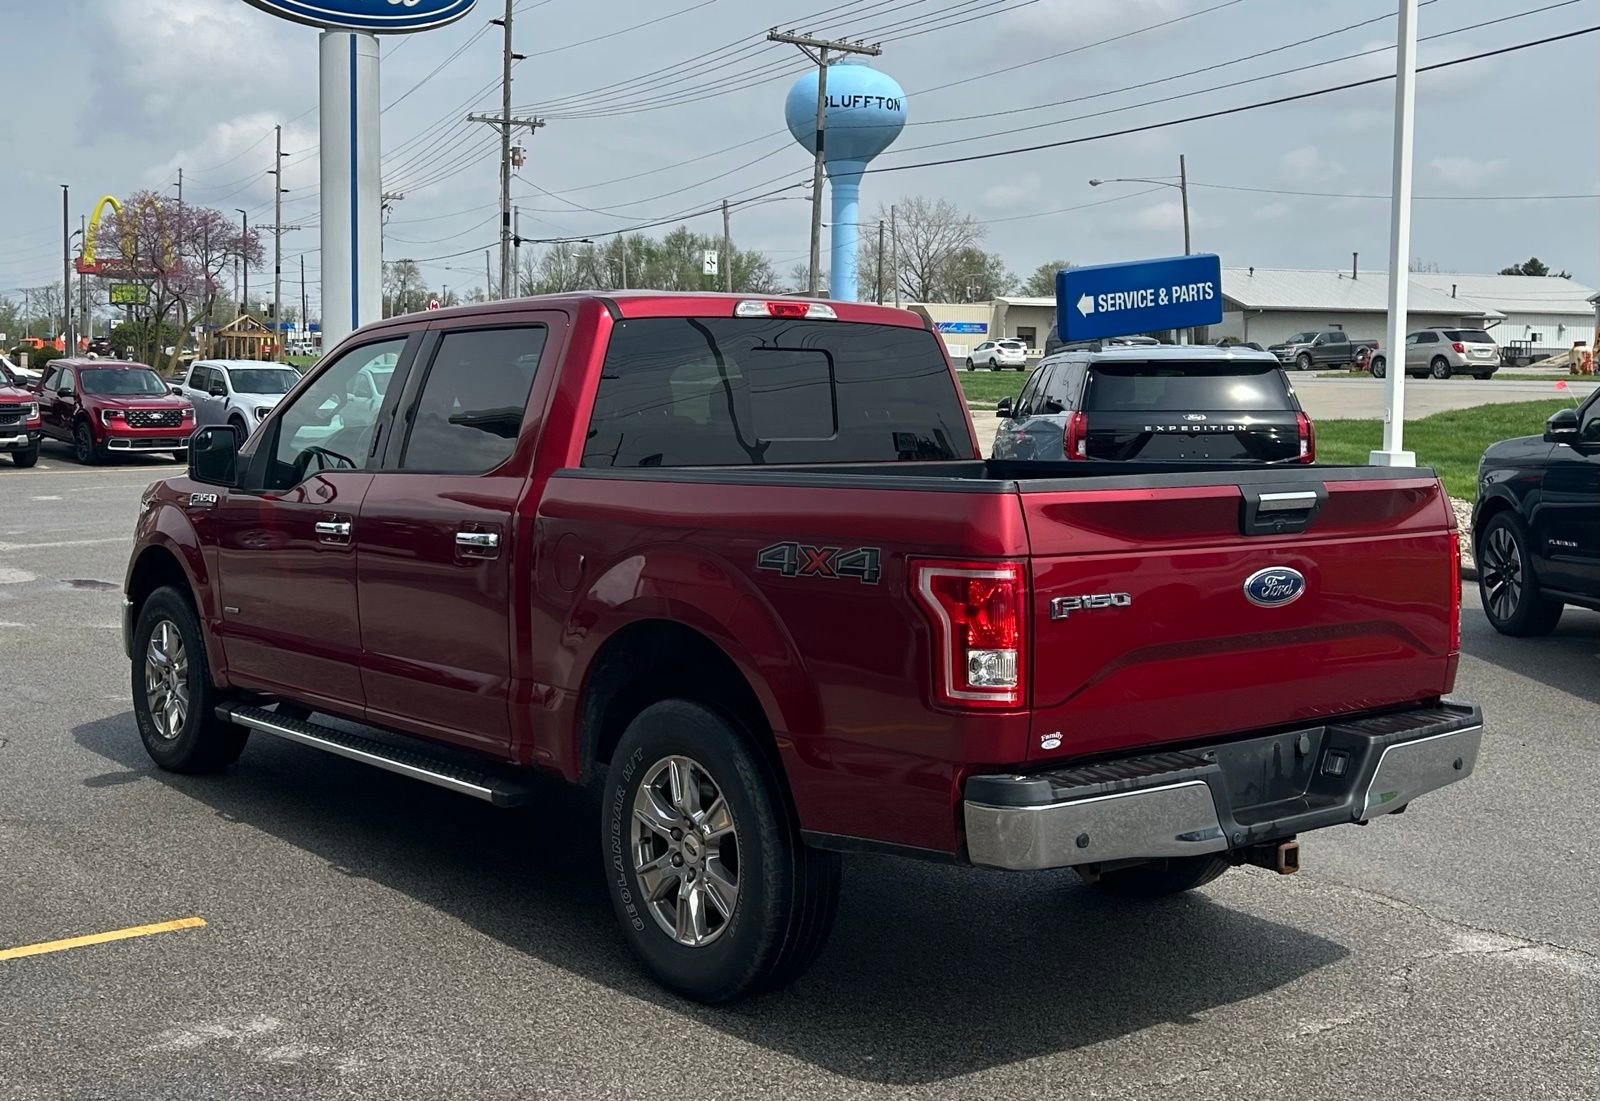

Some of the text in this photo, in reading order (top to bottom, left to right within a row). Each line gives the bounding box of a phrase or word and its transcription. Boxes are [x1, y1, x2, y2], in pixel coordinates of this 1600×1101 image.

[1098, 282, 1214, 312] SERVICE & PARTS
[1261, 575, 1294, 598] Ford
[1041, 731, 1063, 741] Family
[611, 747, 645, 931] GEOLANDAR H/T
